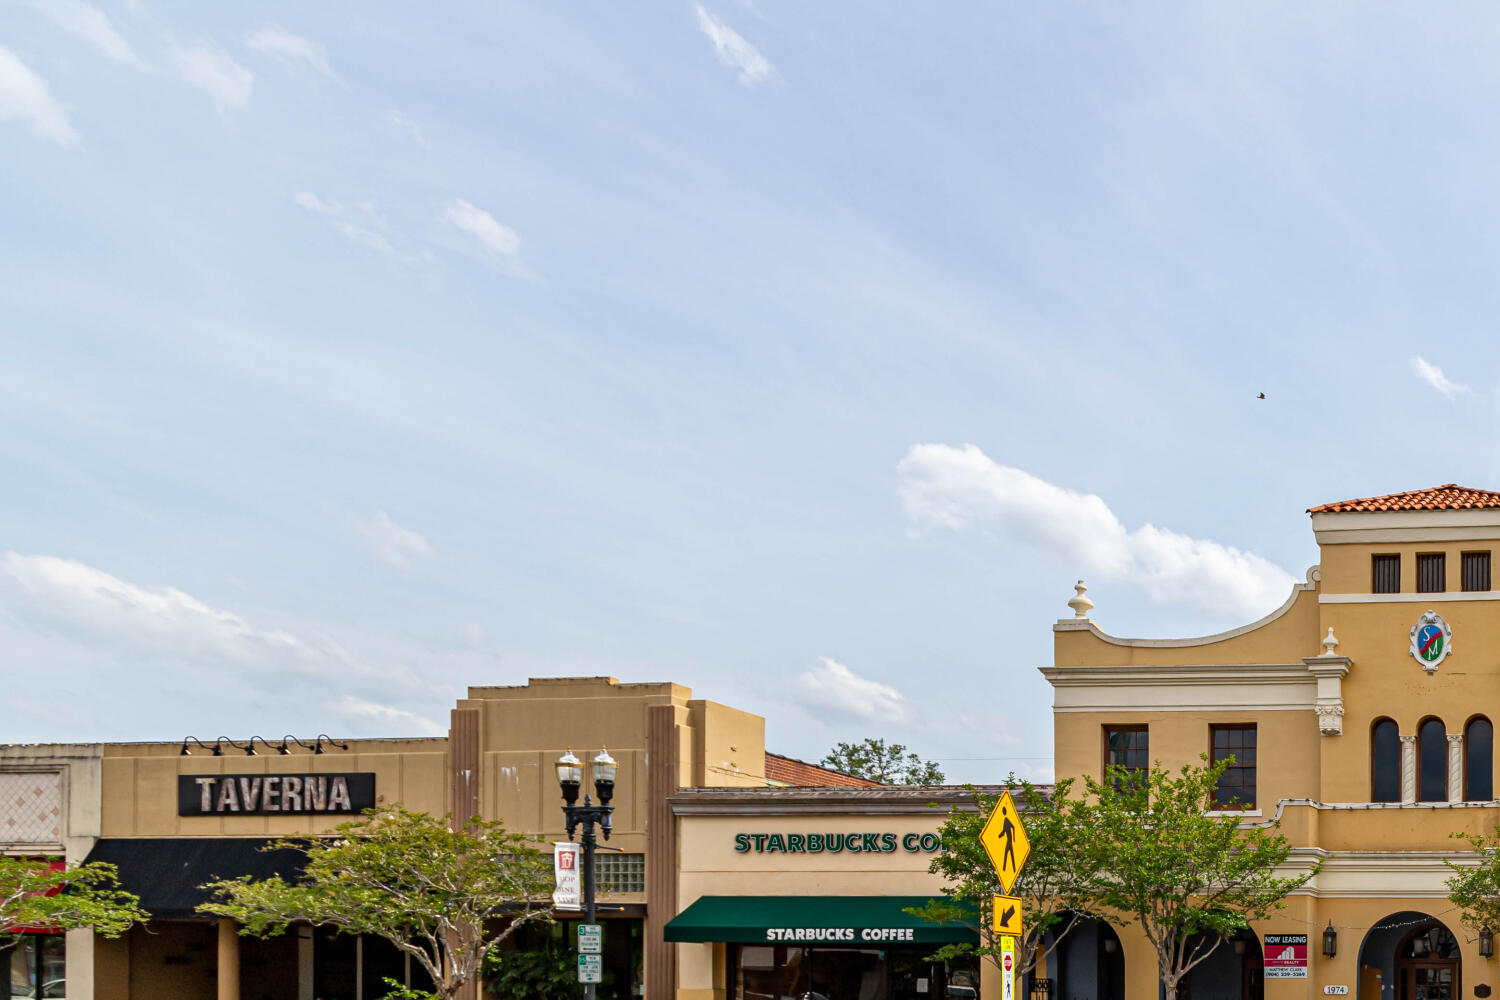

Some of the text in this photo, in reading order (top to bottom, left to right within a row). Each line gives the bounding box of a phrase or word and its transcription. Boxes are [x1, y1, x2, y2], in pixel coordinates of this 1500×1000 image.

[195, 774, 353, 813] TAVERNA
[734, 832, 897, 853] STARBUCKS
[766, 928, 914, 941] STARBUCKS COFFEE
[1264, 936, 1307, 944] NOW LEASING
[1327, 986, 1345, 994] 1974
